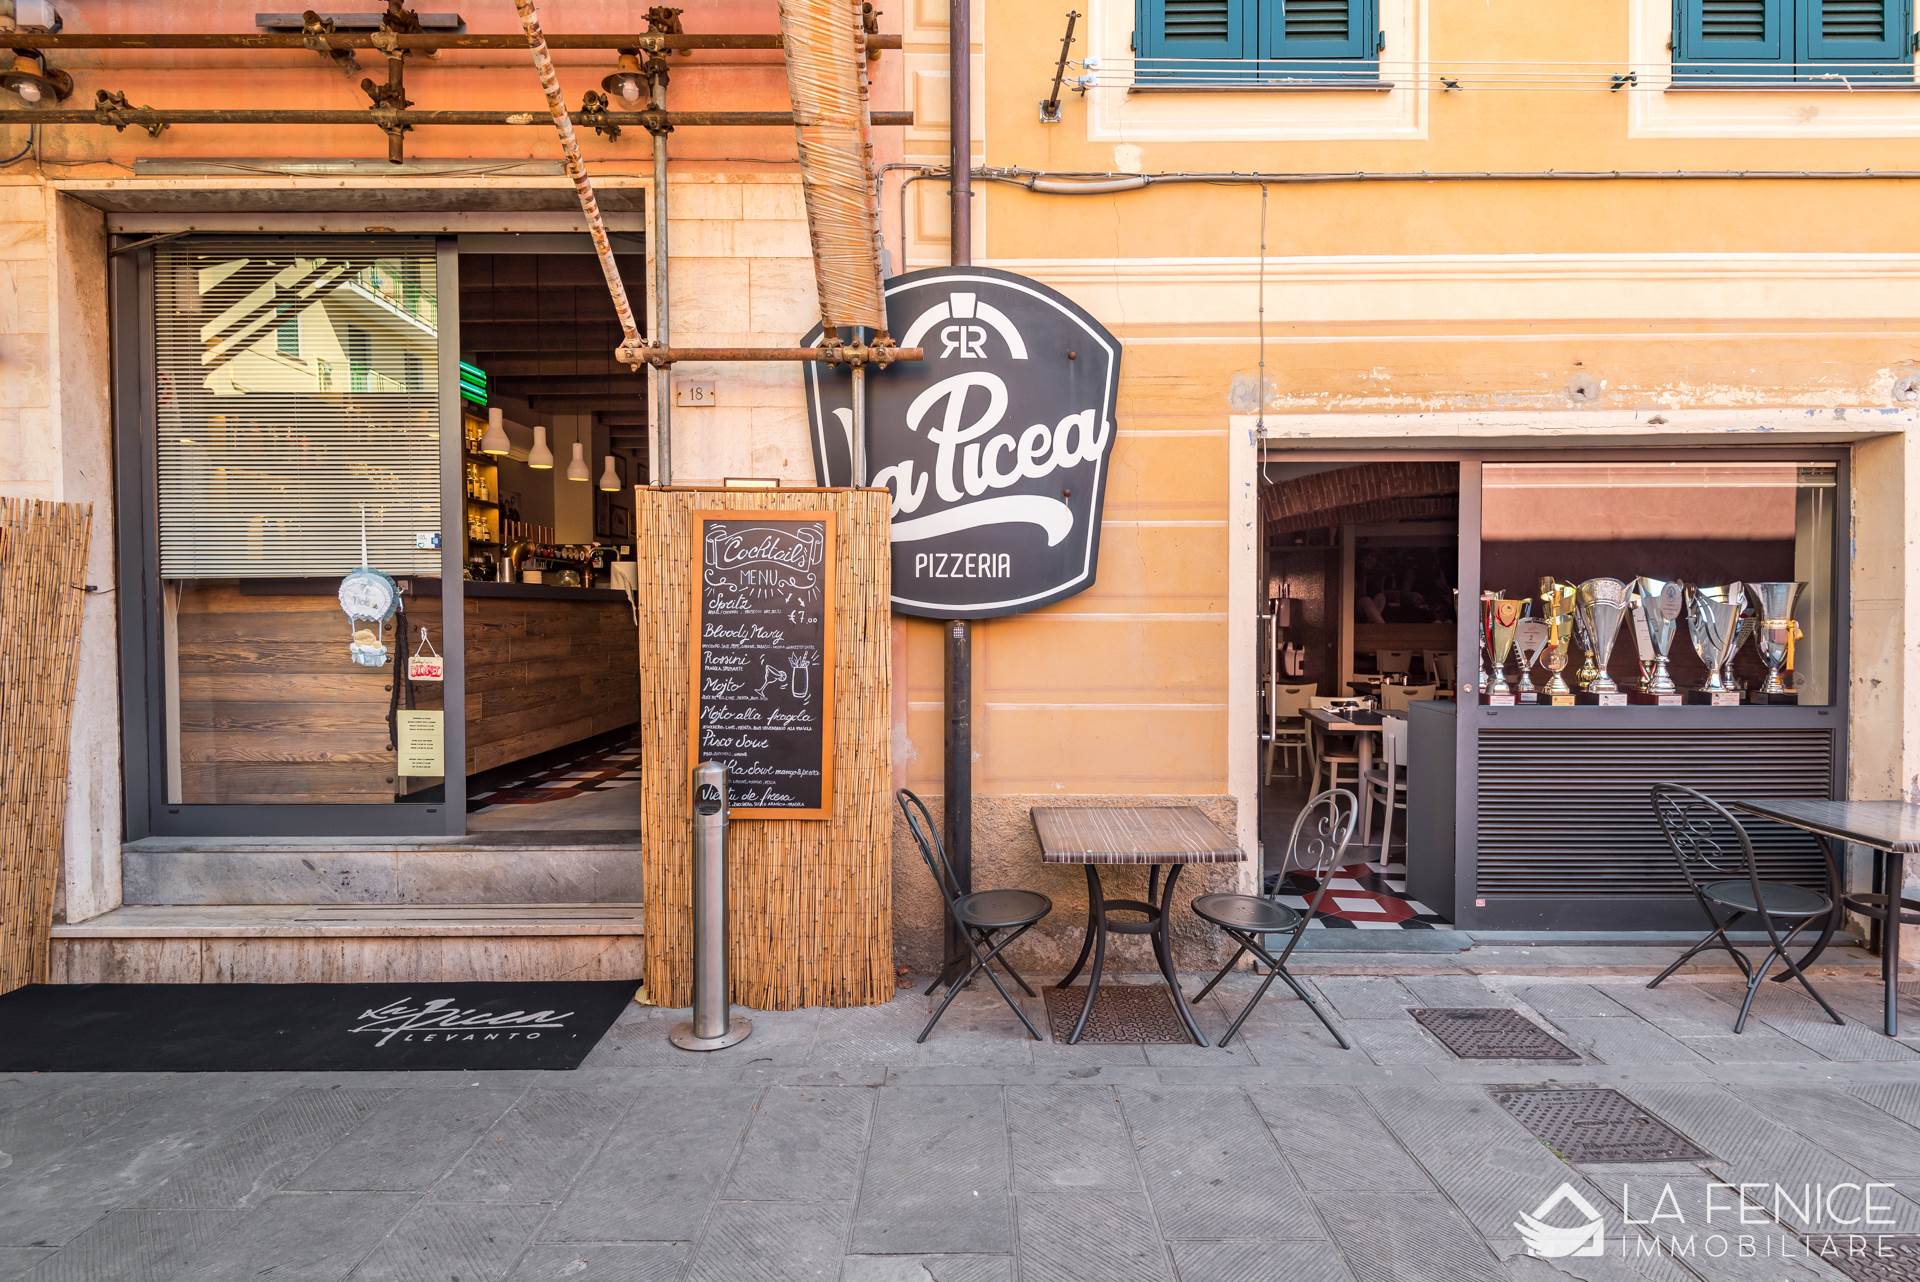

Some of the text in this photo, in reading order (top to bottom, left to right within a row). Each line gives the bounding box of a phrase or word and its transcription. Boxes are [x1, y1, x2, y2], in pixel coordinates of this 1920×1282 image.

[690, 386, 703, 400] 18
[906, 371, 1110, 502] Picea
[723, 535, 806, 567] Cocktails
[915, 553, 1011, 578] PIZZERIA
[740, 570, 778, 586] MENU
[708, 592, 752, 612] Spritz
[703, 622, 784, 645] Bloody Mary
[704, 650, 751, 665] Rossini
[734, 707, 763, 721] alla
[767, 708, 817, 727] fragola
[702, 729, 769, 748] Pisco Sour
[747, 761, 775, 775] Sour
[741, 788, 759, 800] de
[760, 787, 796, 806] fresa
[404, 1032, 542, 1042] LEVANTO
